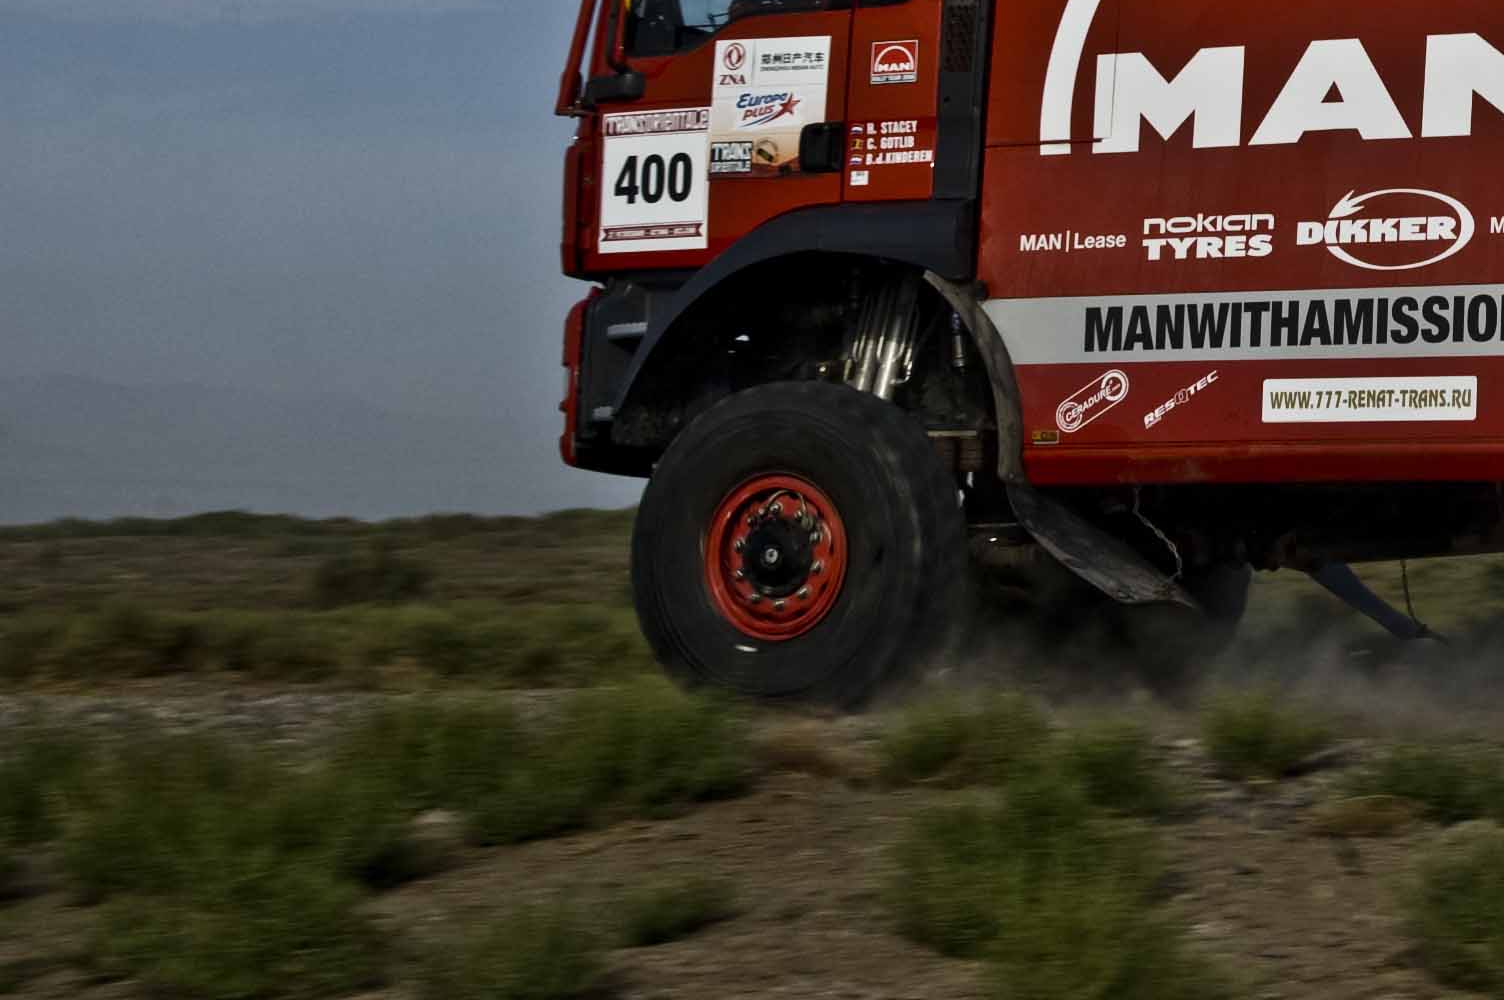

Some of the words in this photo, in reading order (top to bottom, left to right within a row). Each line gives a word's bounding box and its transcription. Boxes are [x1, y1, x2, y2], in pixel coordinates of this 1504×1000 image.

[875, 61, 913, 73] MAN
[719, 73, 746, 86] ZNA
[880, 120, 918, 134] STACEY
[614, 152, 693, 205] 400
[1019, 233, 1062, 252] MAN
[1074, 231, 1127, 250] Lease
[1142, 234, 1273, 261] TYRES
[1270, 389, 1472, 410] WWW.777-RENAT-TRANS.RU
